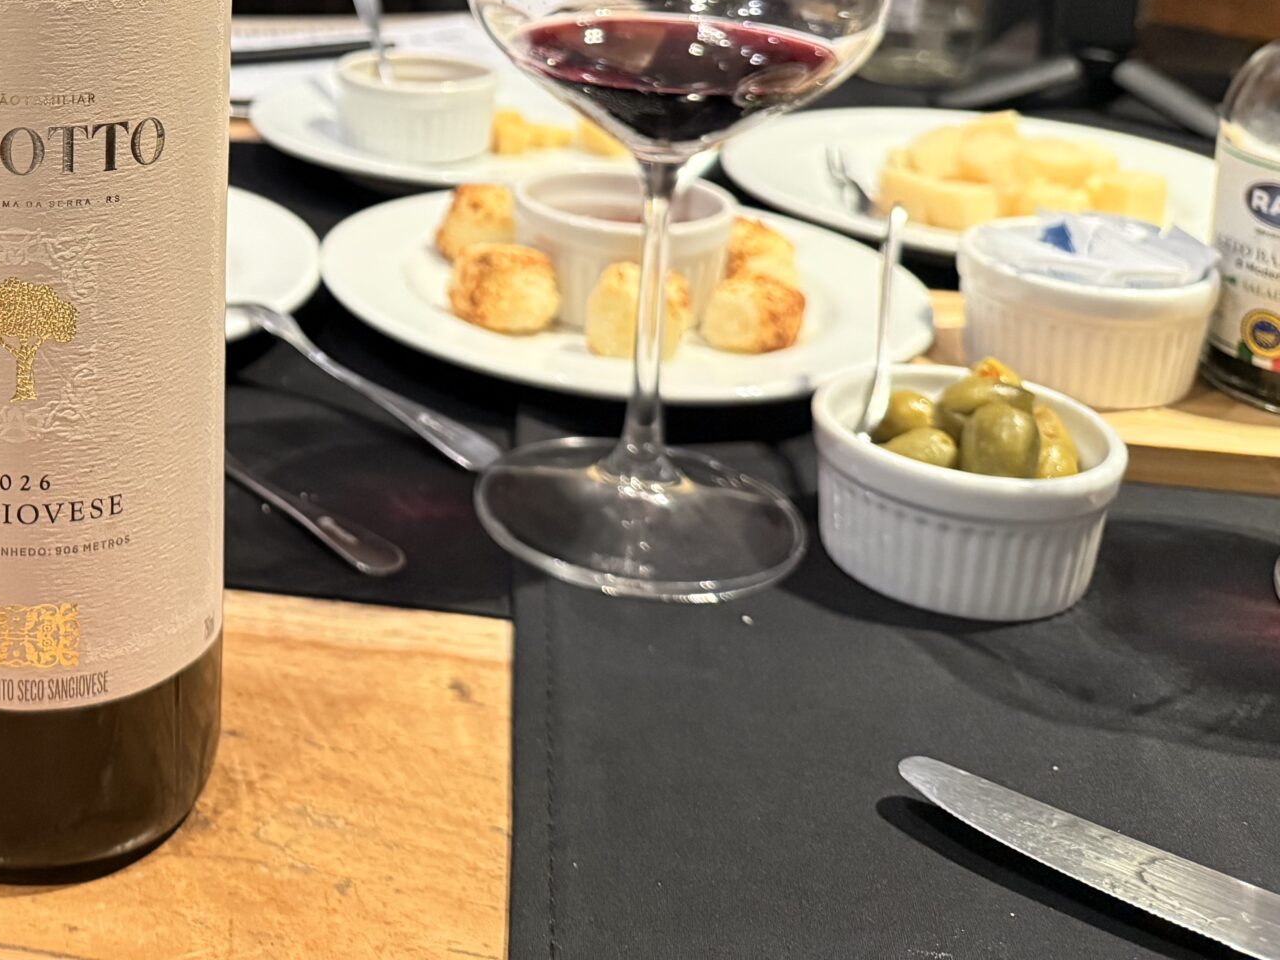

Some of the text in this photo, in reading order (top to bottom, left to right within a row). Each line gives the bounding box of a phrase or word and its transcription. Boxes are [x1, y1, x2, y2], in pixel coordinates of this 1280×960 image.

[25, 199, 43, 209] DA
[48, 198, 92, 209] SERRA
[105, 194, 121, 204] RS
[55, 543, 79, 555] 906
[82, 534, 131, 553] METROS
[17, 678, 45, 702] SECO
[47, 670, 110, 701] SANGIOVESE
